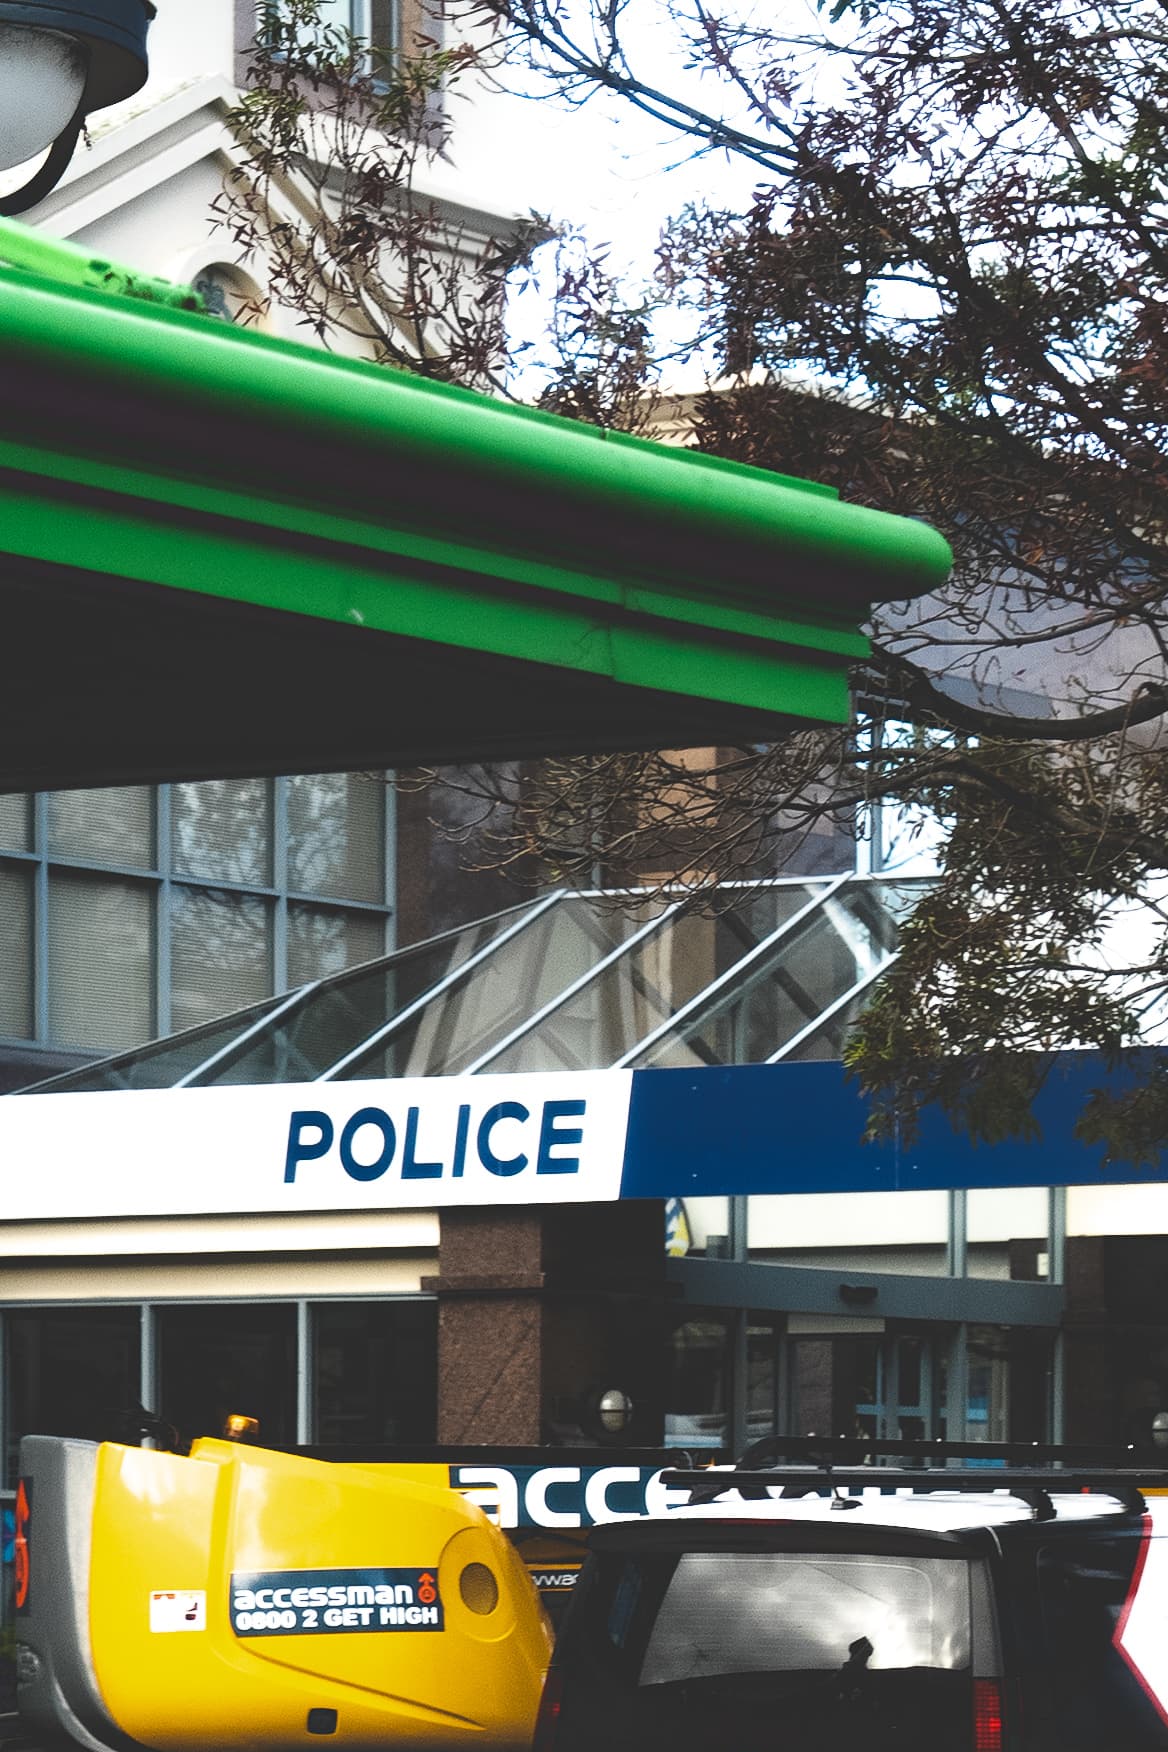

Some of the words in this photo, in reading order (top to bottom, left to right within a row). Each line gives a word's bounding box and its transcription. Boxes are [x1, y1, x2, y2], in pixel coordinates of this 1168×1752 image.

[284, 1099, 586, 1183] POLICE
[234, 1585, 414, 1611] accessman
[235, 1609, 297, 1631] 0800
[302, 1609, 318, 1629] 2
[323, 1607, 373, 1628] GET
[380, 1606, 438, 1626] HIGH
